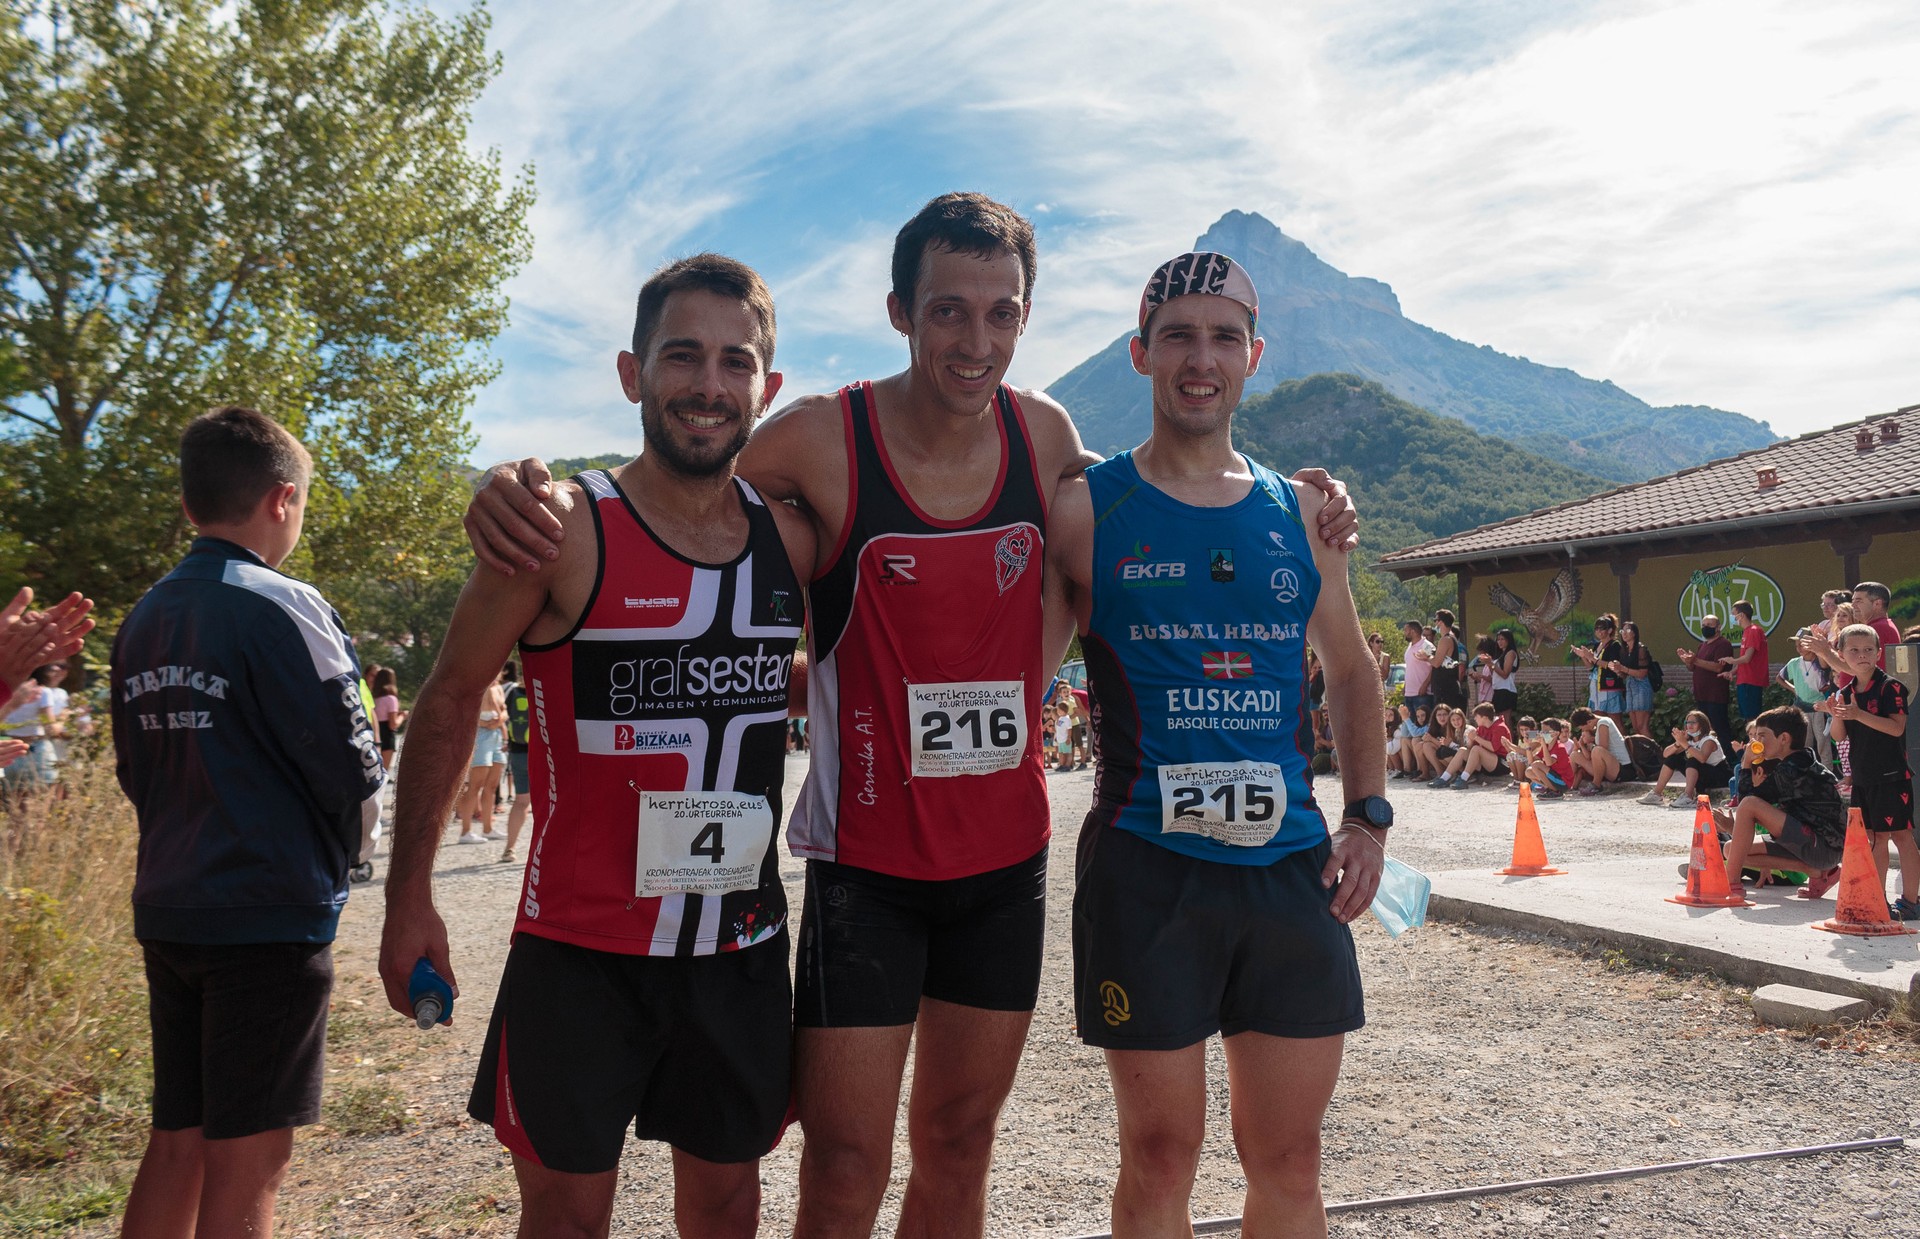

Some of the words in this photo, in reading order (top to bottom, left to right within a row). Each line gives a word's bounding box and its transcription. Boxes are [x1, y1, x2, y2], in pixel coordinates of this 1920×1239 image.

[1123, 562, 1186, 580] EKFB
[915, 689, 1017, 701] herrikrosa.eus
[1166, 687, 1281, 713] EUSKADI
[639, 701, 694, 710] IMAGEN
[921, 708, 1017, 751] 216
[1167, 717, 1219, 730] BASQUE
[1221, 717, 1282, 731] COUNTRY
[636, 733, 692, 746] BIZKAIA
[1166, 767, 1274, 781] herrikrosa.eus
[649, 796, 763, 810] herrikrosa.eus
[1173, 784, 1275, 822] 215
[674, 810, 743, 819] 20.URTEURRENA
[690, 822, 726, 864] 4
